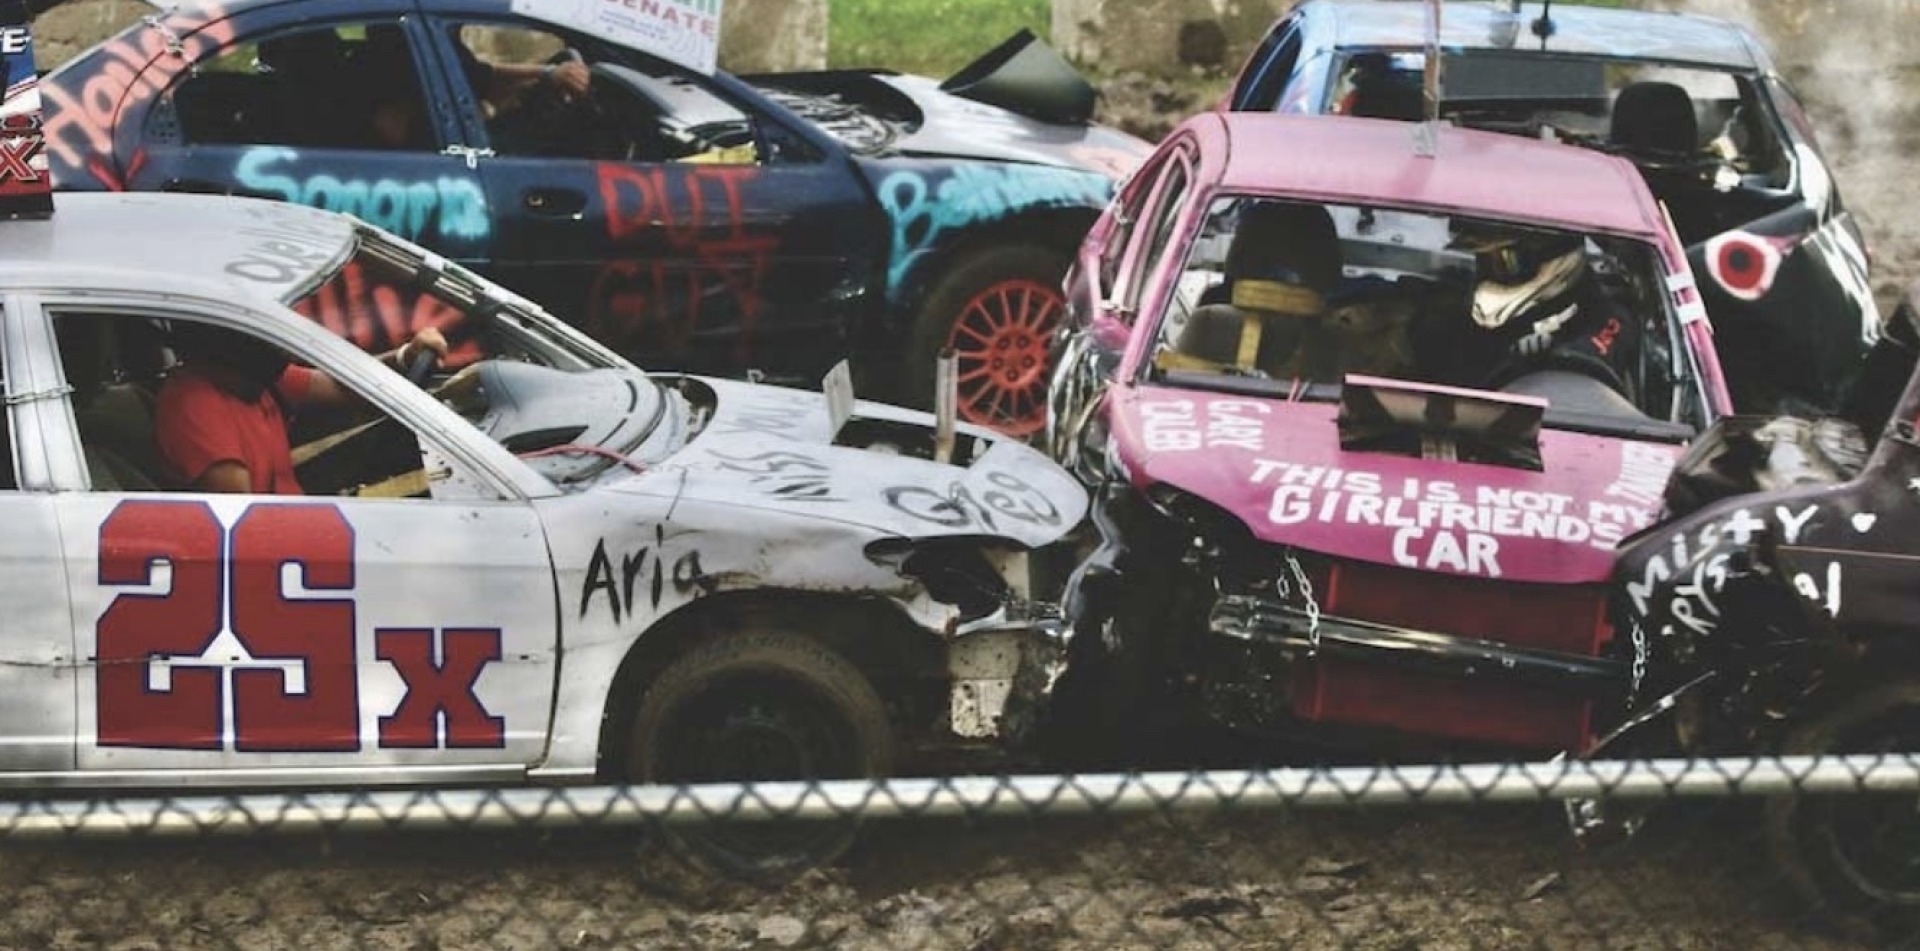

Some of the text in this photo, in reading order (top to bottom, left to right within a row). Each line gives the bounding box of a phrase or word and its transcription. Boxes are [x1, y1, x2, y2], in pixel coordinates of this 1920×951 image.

[604, 0, 715, 36] ENATE
[1248, 459, 1665, 532] THIS IS NOT MY
[1267, 485, 1624, 551] GIRLFRIENDS
[579, 523, 704, 625] Aria
[1391, 526, 1503, 579] CAR
